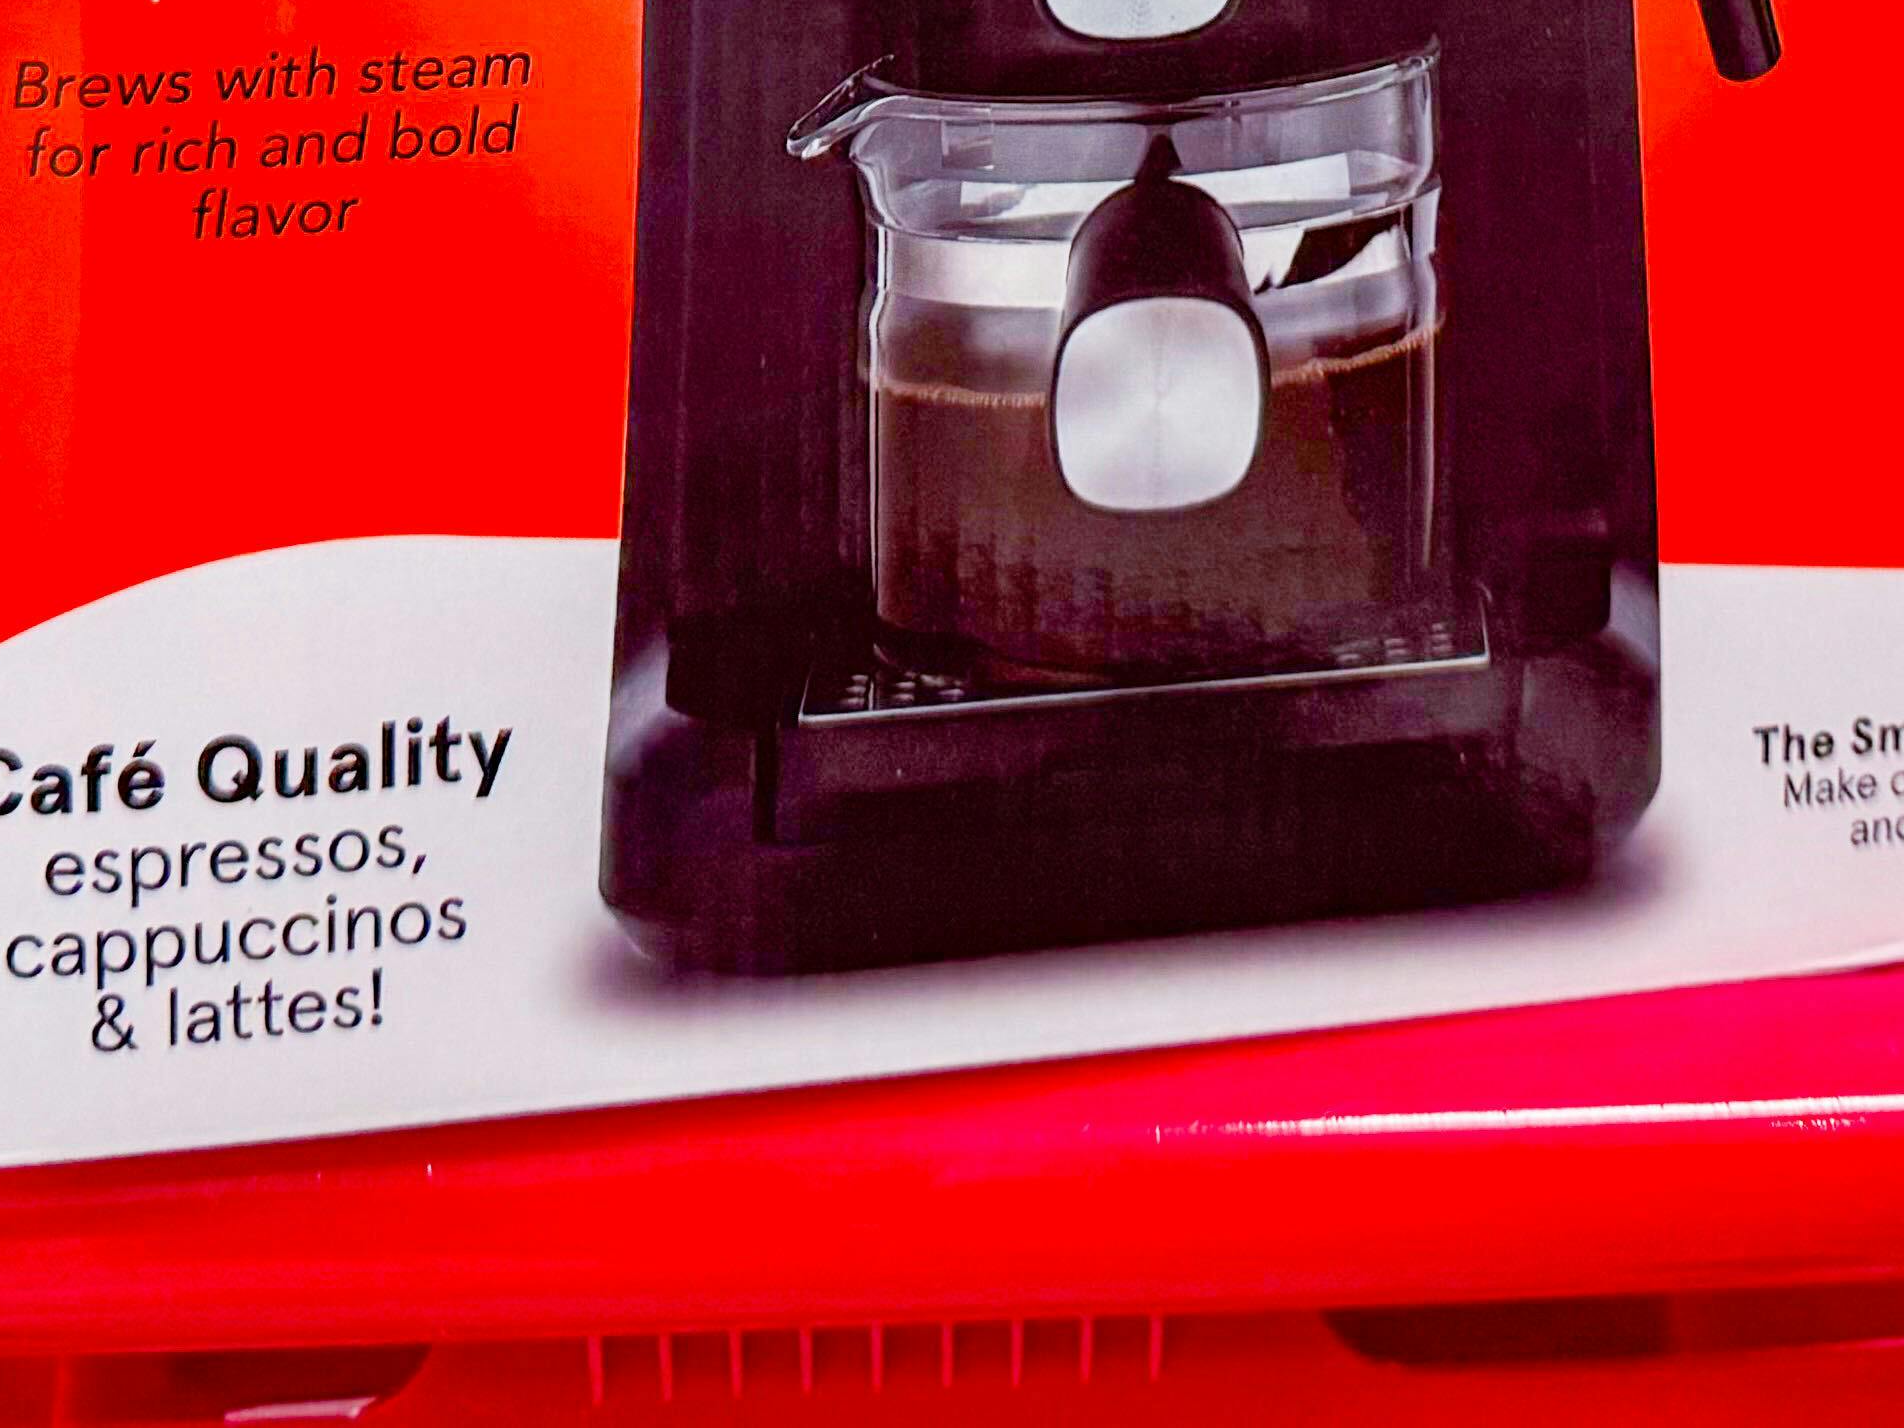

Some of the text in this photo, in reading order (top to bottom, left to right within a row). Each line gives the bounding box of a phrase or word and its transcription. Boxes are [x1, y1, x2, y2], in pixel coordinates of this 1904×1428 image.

[13, 47, 532, 111] Brews with steam
[26, 104, 520, 178] for rich and bold
[193, 188, 360, 239] flavor
[197, 714, 513, 804] Quality
[1752, 723, 1836, 765] The
[1782, 761, 1880, 809] Make
[44, 822, 426, 908] espressos,
[5, 894, 467, 988] cappuccinos
[91, 967, 383, 1053] & lattes!
